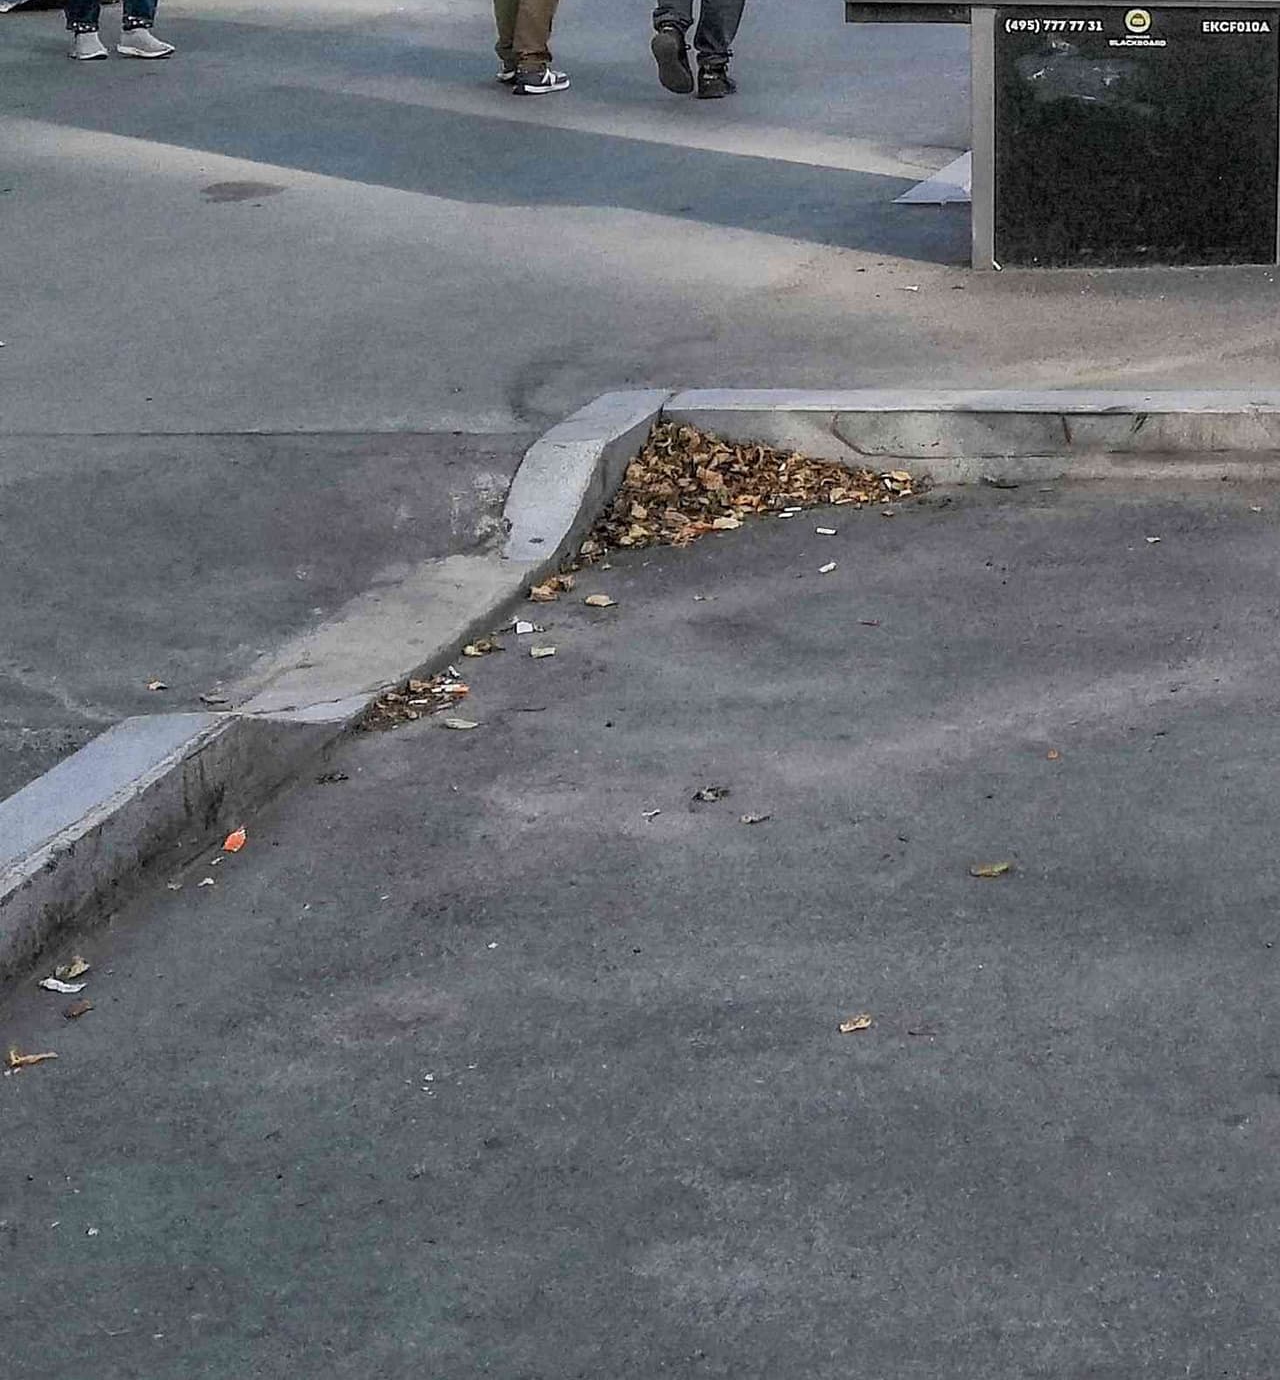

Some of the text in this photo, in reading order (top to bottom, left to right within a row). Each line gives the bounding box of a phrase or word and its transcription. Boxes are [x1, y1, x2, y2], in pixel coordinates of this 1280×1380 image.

[1005, 19, 1104, 33] (495) 777 77 31
